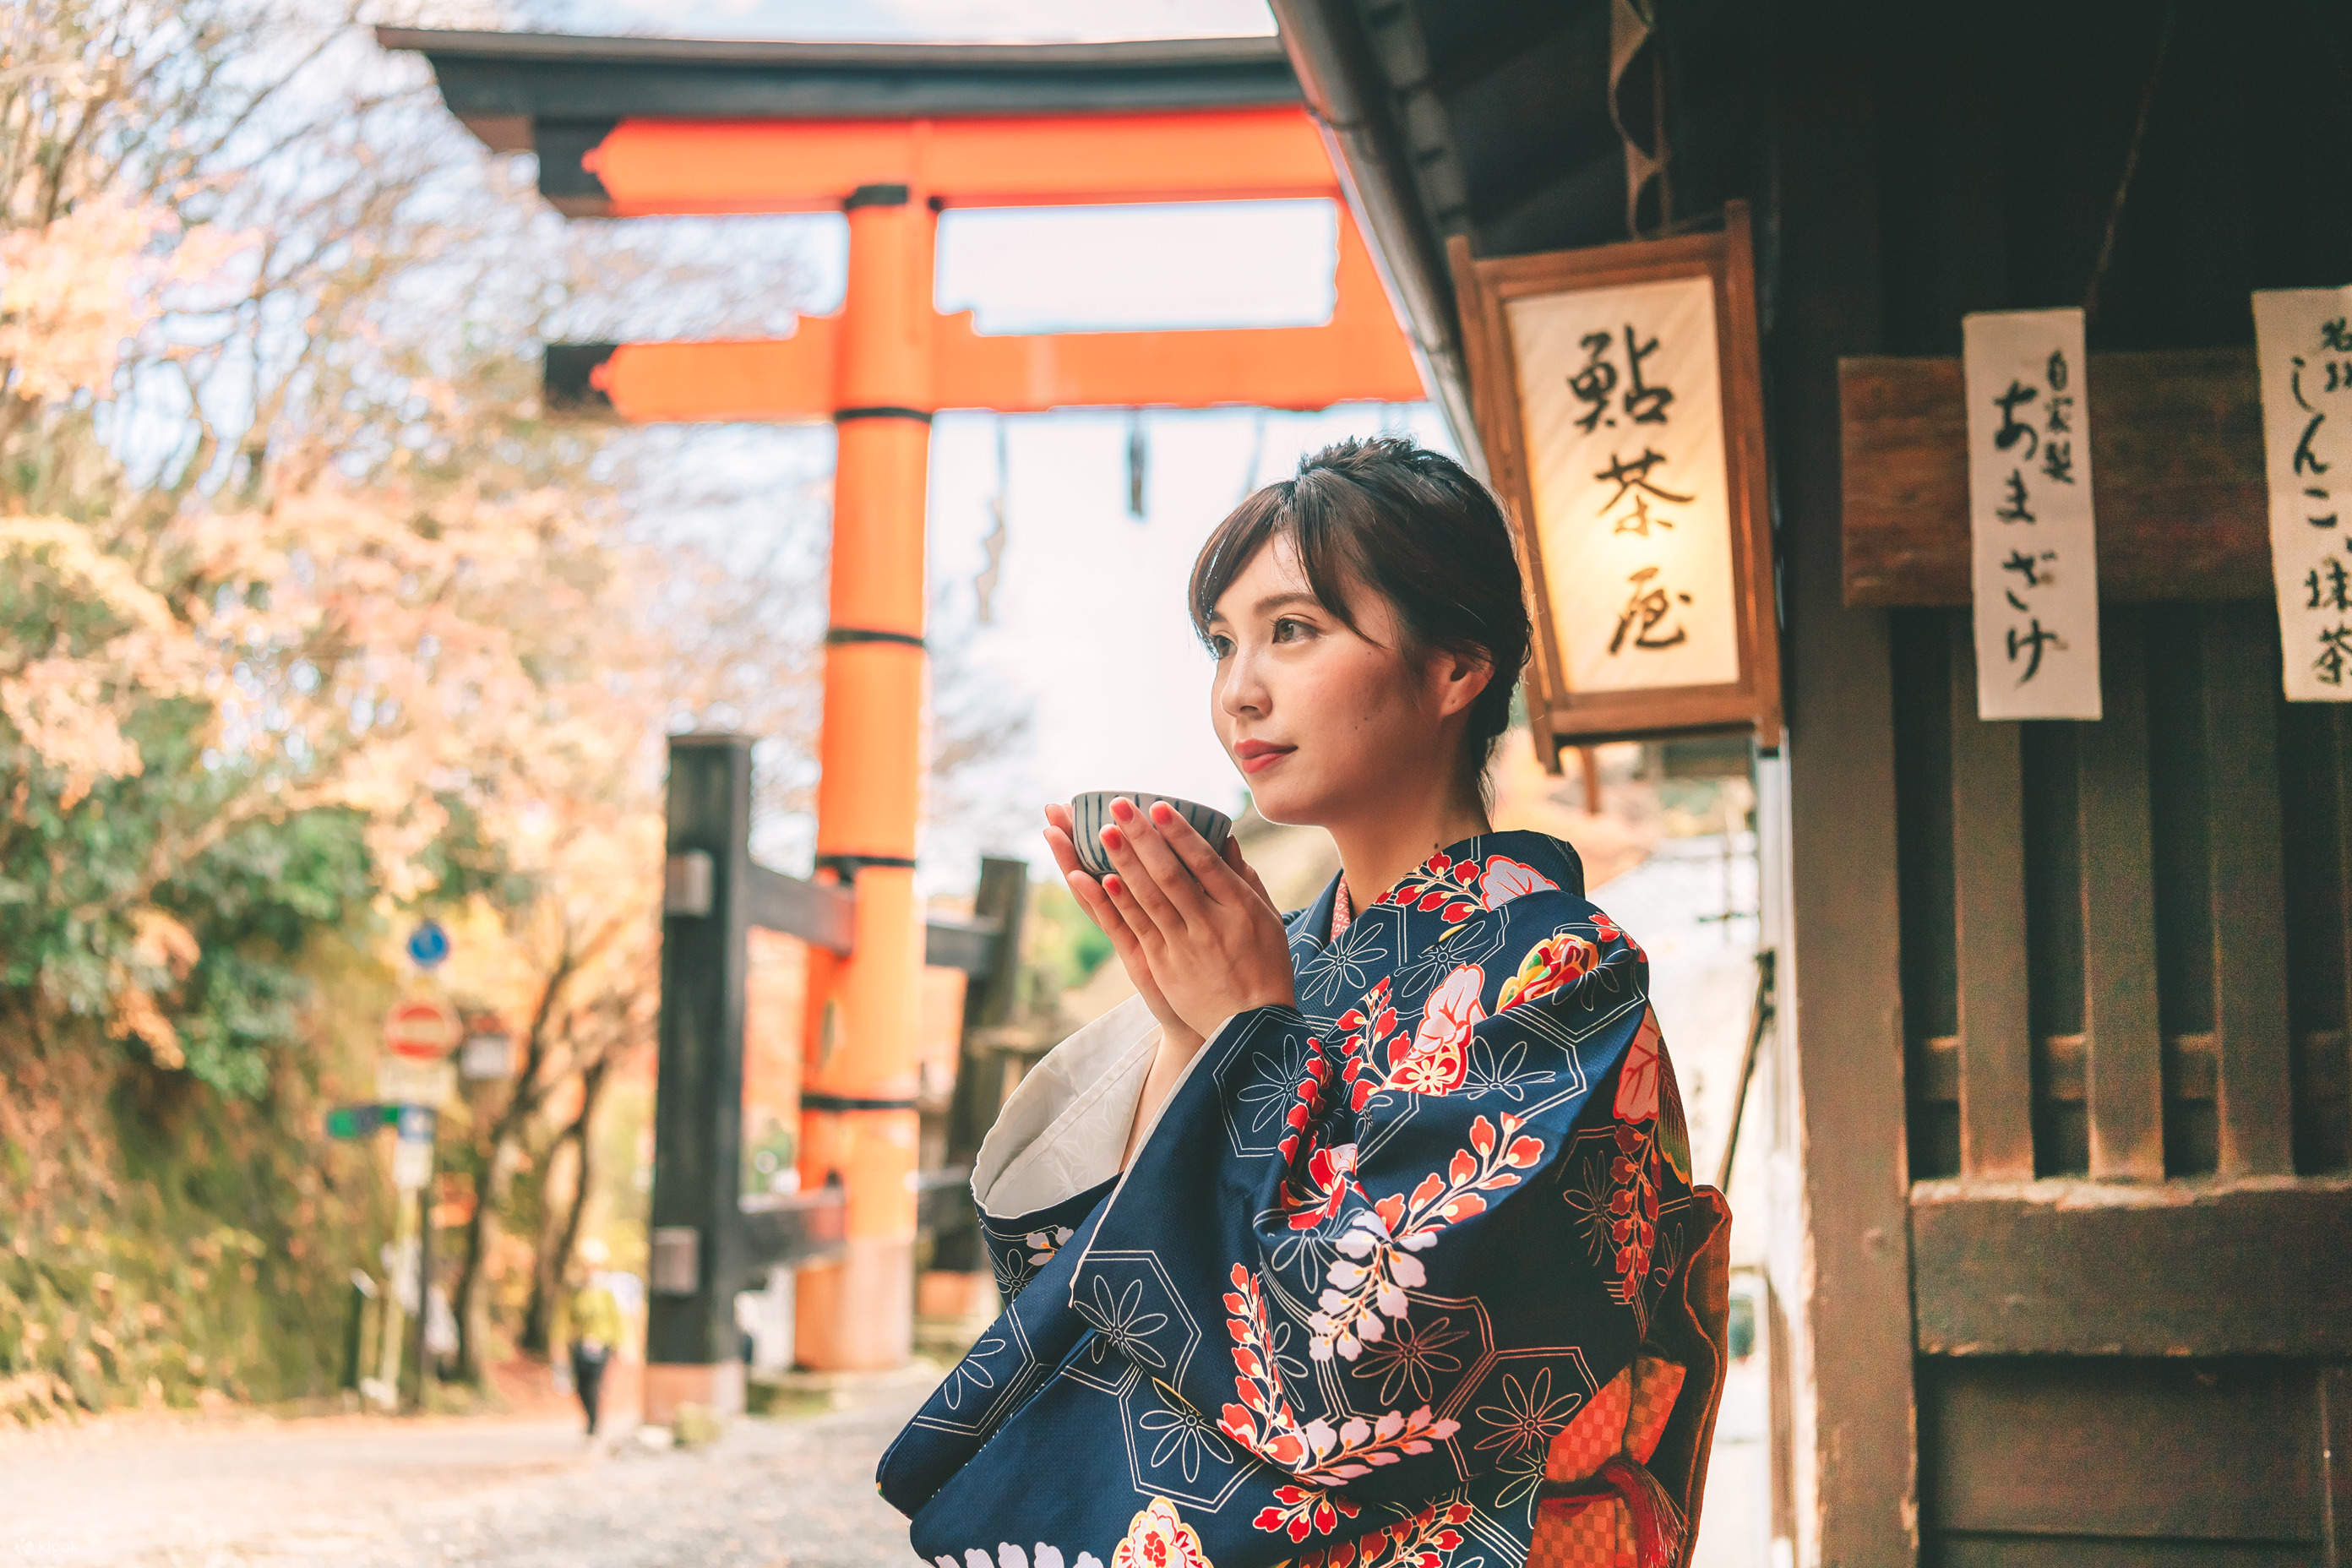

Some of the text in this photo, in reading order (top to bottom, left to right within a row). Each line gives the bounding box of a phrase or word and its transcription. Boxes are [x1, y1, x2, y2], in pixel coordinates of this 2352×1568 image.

[1567, 322, 1695, 655] 鮎茶屋
[1993, 378, 2066, 689] あまざけ
